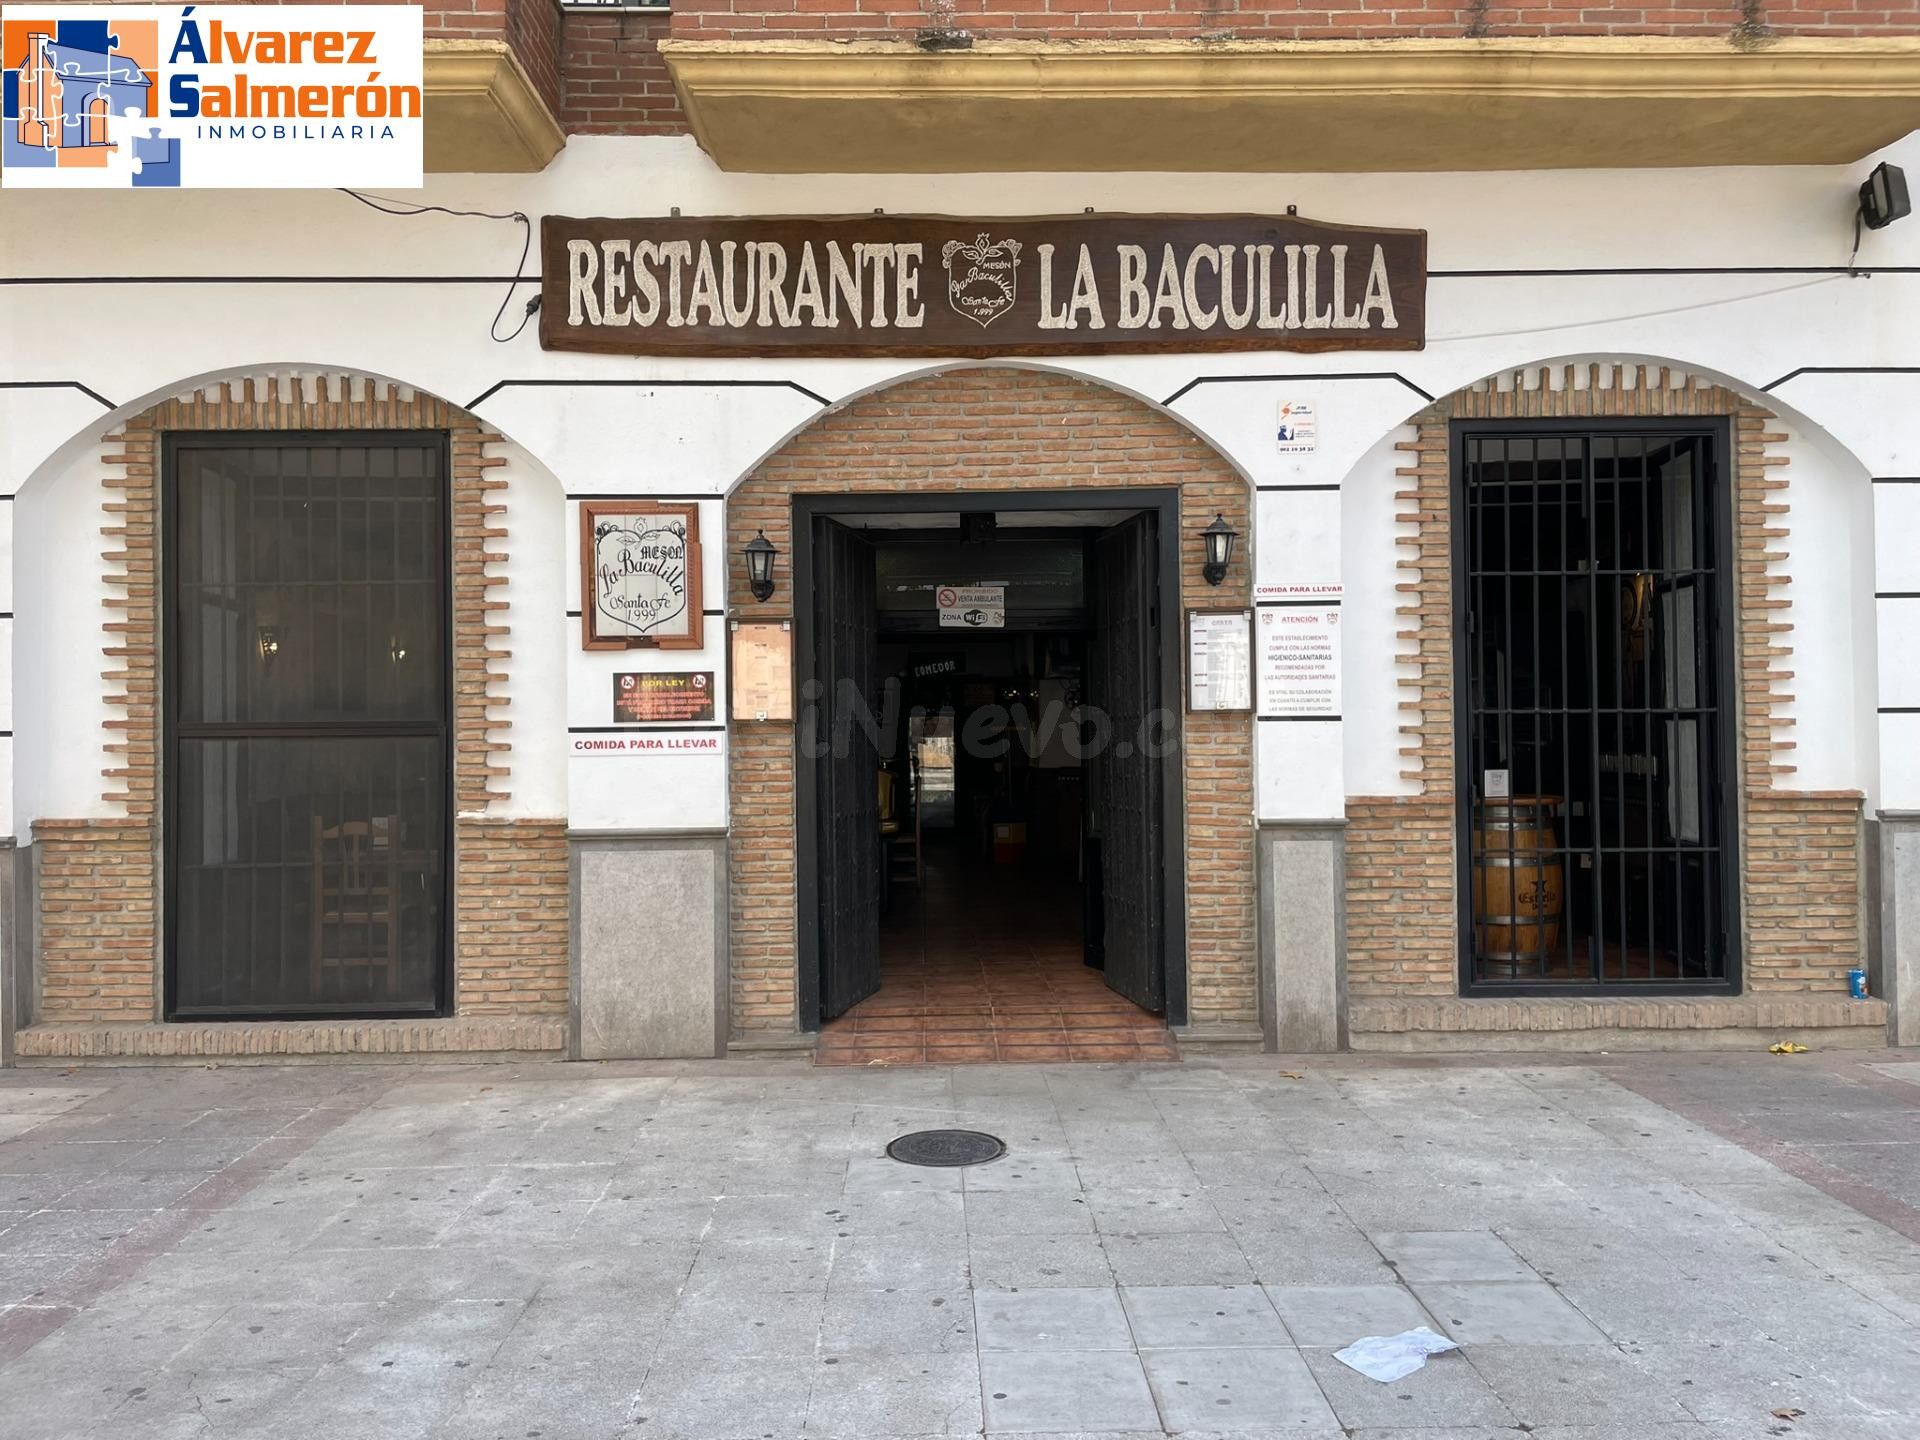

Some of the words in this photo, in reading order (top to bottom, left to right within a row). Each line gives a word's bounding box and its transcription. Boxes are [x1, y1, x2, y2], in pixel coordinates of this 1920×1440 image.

[567, 239, 926, 329] RESTAURANTE
[1036, 243, 1106, 330] LA
[1116, 242, 1399, 330] BACULILLA
[600, 563, 619, 599] La
[617, 549, 684, 597] Baculilla
[1256, 586, 1288, 594] COMIDA
[609, 592, 649, 610] Santa
[650, 592, 672, 611] Fe
[958, 594, 973, 602] VENTA
[974, 594, 1003, 602] AMBULANTE
[941, 613, 962, 621] ZONA
[1281, 615, 1319, 623] ATENCIÓN
[914, 660, 957, 677] COMEDOR
[574, 740, 626, 750] COMIDA
[630, 739, 664, 749] PARA
[667, 738, 717, 749] LLEVAR
